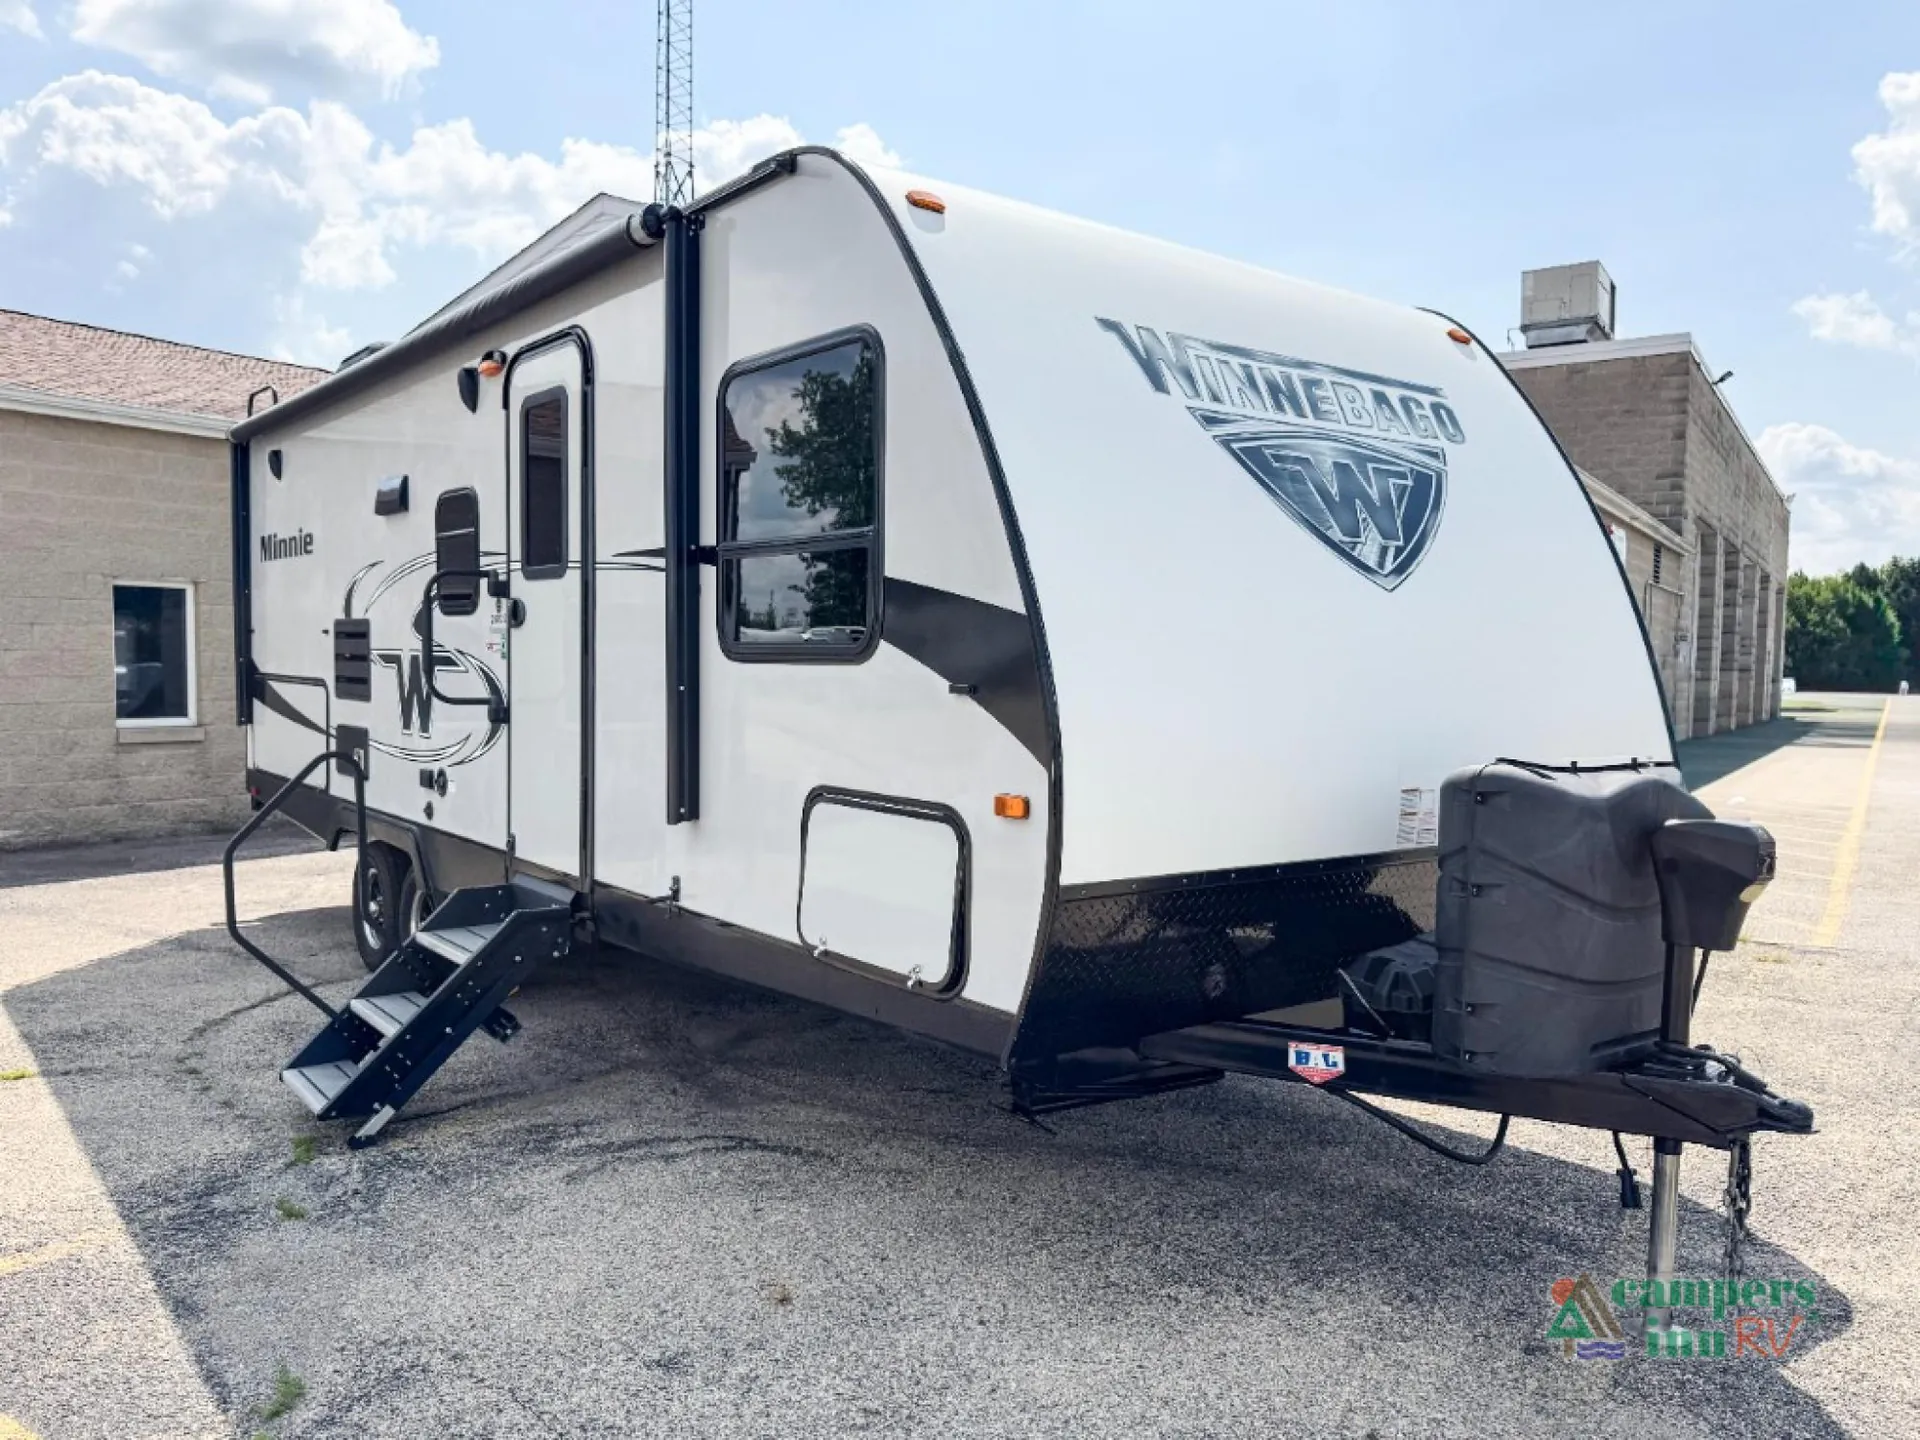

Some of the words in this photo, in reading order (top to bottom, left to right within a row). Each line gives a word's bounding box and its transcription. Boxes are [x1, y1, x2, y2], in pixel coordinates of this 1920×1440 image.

[1095, 316, 1466, 444] WINNEBAGO
[1262, 446, 1414, 546] W
[260, 527, 314, 563] Minnie
[370, 649, 468, 739] W
